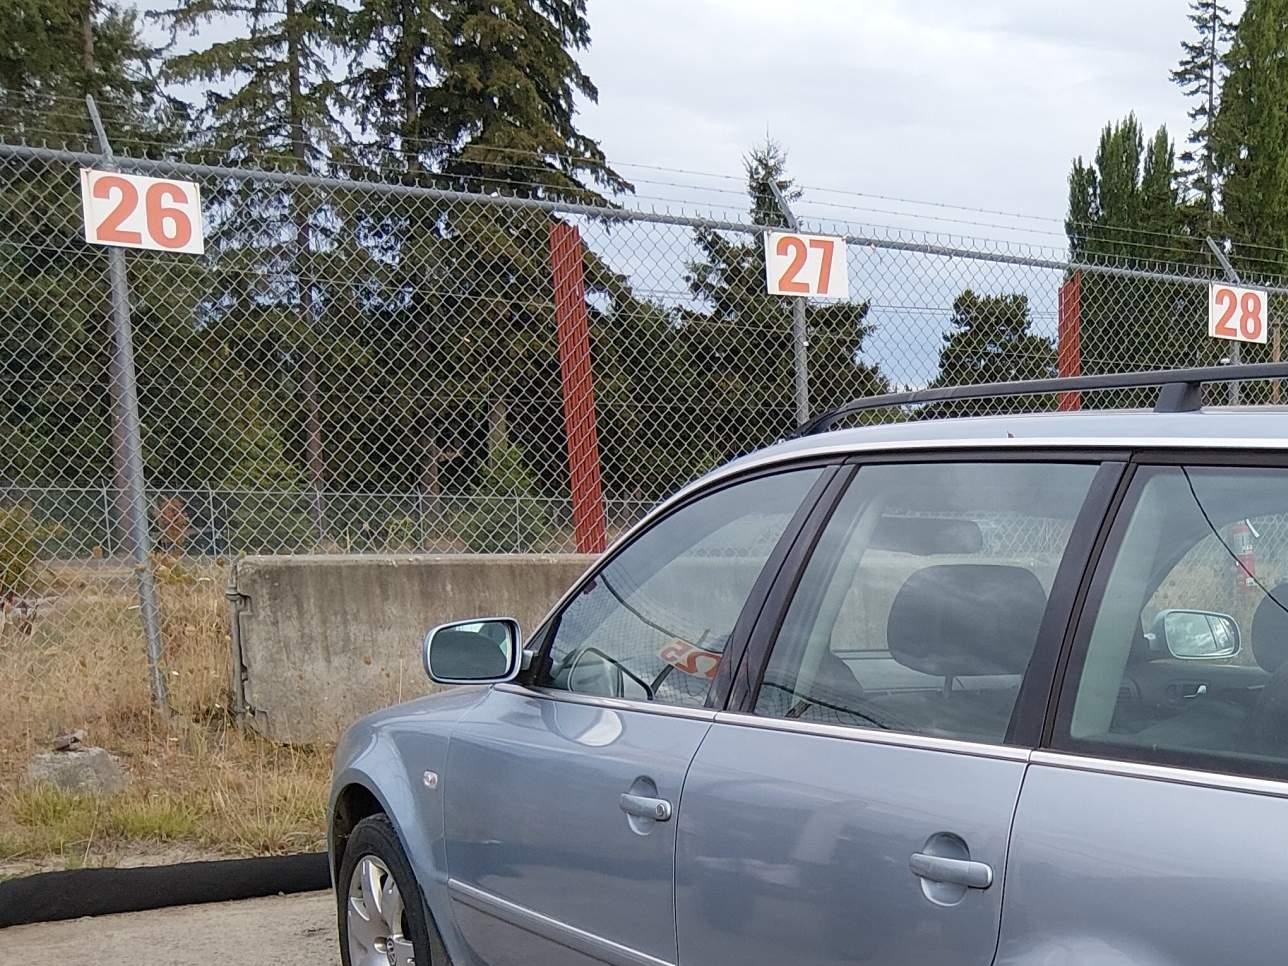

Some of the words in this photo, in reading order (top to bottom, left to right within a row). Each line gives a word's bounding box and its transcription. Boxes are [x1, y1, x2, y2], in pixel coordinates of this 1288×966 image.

[93, 175, 192, 249] 26
[775, 235, 836, 295] 27
[1213, 288, 1263, 341] 28
